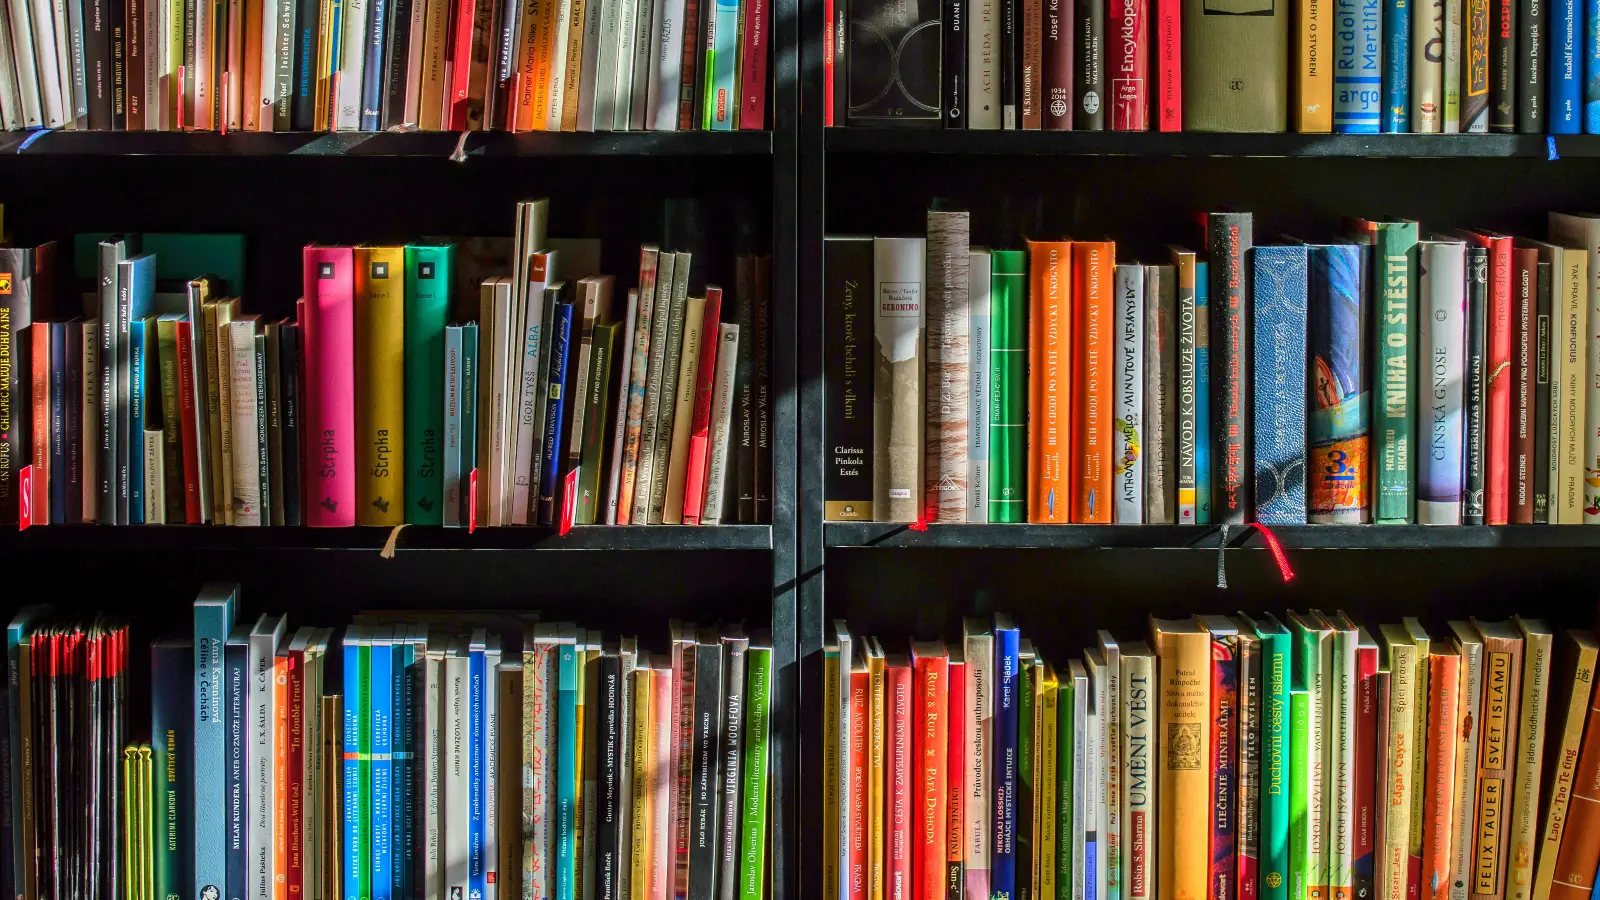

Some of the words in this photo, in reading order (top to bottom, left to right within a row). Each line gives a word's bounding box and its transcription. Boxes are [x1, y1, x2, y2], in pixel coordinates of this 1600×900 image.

[527, 24, 537, 44] Rilke
[1050, 14, 1058, 40] Josef
[1338, 0, 1355, 69] Rudolf
[1530, 24, 1539, 56] Deprijck
[281, 33, 290, 69] leichter
[502, 28, 510, 64] Podracká
[524, 46, 535, 73] Maria
[982, 29, 991, 64] BĚDA,
[523, 76, 532, 105] Rainer
[1024, 66, 1032, 105] SLOBODNÍK
[1339, 90, 1378, 110] argo
[1024, 107, 1031, 115] M.
[943, 252, 953, 287] pravěku
[1049, 250, 1059, 299] INKOGNITO
[1089, 250, 1099, 299] INKOGNITO
[1229, 260, 1239, 288] Bardo
[1570, 264, 1578, 280] TAK
[1384, 255, 1408, 324] ŠTĚSTÍ
[1570, 282, 1578, 311] PRAVIL
[0, 308, 9, 322] INÉ
[1179, 296, 1193, 344] ŽIVOTA
[0, 331, 10, 356] DÚHU
[85, 331, 94, 363] PÍSNÍ
[527, 325, 538, 357] ALBA
[1387, 334, 1407, 347] O
[1569, 314, 1577, 363] KONFUCIUS
[85, 371, 94, 404] PÍSEŇ
[525, 371, 535, 396] TYŠŠ
[1049, 380, 1058, 391] PO
[1089, 380, 1098, 391] PO
[1124, 348, 1135, 407] MINUTOVÉ
[1183, 348, 1193, 404] OBSLUZE
[1386, 356, 1407, 418] KNIHA
[1435, 347, 1447, 400] GNOSE
[1471, 355, 1480, 402] SATURNI
[1569, 374, 1577, 397] KNIHY
[1, 393, 10, 430] CHLAPEC
[523, 400, 533, 425] IGOR
[741, 385, 750, 407] VÁLEK
[758, 385, 767, 408] VÁLEK
[1047, 395, 1058, 424] CHODÍ
[1088, 395, 1098, 424] CHODÍ
[1183, 405, 1193, 415] K
[548, 404, 557, 434] TENNYSON
[742, 409, 750, 446] MIROSLAV
[759, 410, 767, 447] MIROSLAV
[1431, 406, 1447, 460] ČÍNSKÁ
[1568, 399, 1578, 441] MOUDRÝCH
[371, 429, 392, 477] Štrpka
[417, 429, 436, 477] Štrpka
[546, 436, 554, 459] ALFRED
[1180, 420, 1193, 467] NÁVOD
[1397, 440, 1407, 470] RICARD
[835, 457, 864, 465] Pinkola
[1519, 455, 1527, 480] STEINER
[654, 482, 662, 498] Ivan
[1124, 457, 1134, 503] ANTHONY
[200, 638, 209, 669] Céline
[212, 638, 221, 664] Anna
[1533, 648, 1543, 685] meditace
[258, 657, 266, 683] ČAPEK
[755, 667, 764, 701] Východu
[1003, 656, 1011, 683] Sládek
[1270, 653, 1283, 695] islámu
[200, 680, 211, 721] Čechách
[211, 667, 221, 723] Kareninová
[232, 668, 241, 718] LITERATURA?
[606, 675, 615, 708] HODINÁŘ
[895, 684, 905, 715] ŽIVOTU
[974, 669, 982, 725] anthroposofií
[1003, 687, 1011, 707] Karel
[1127, 673, 1147, 725] VÉST
[1491, 658, 1505, 718] ISLÁMU
[290, 704, 300, 735] double
[728, 695, 739, 745] WOOLFOVÁ
[754, 704, 763, 742] arabského
[1528, 688, 1539, 740] buddhistické
[167, 730, 175, 751] ROMÁN
[232, 720, 240, 746] ZMŮŽE
[973, 728, 982, 756] českou
[1218, 700, 1229, 769] MINERÁLMI
[1488, 728, 1501, 764] SVĚT
[233, 747, 240, 758] CO
[751, 745, 761, 780] literatury
[1268, 736, 1282, 795] Duchovní
[1394, 734, 1404, 767] Cayce
[232, 760, 240, 780] ANEB
[726, 750, 737, 794] VIRGINIA
[1126, 734, 1147, 807] UMĚNÍ
[232, 783, 240, 821] KUNDERA
[750, 782, 759, 816] Moderní
[1004, 781, 1012, 818] MYSTICKÉ
[1216, 775, 1228, 828] LIEČENIE
[1393, 772, 1404, 805] Edgar
[167, 791, 176, 820] CLARKOVÁ
[895, 799, 903, 824] CESTA
[1484, 785, 1496, 838] TAUER
[168, 822, 176, 850] KATERINA
[748, 828, 758, 862] Oliverius
[1133, 815, 1143, 851] Sharma
[1547, 823, 1560, 841] Lao
[747, 865, 757, 894] Jaroslav
[1133, 865, 1143, 893] Robin
[1481, 846, 1492, 887] FELIX
